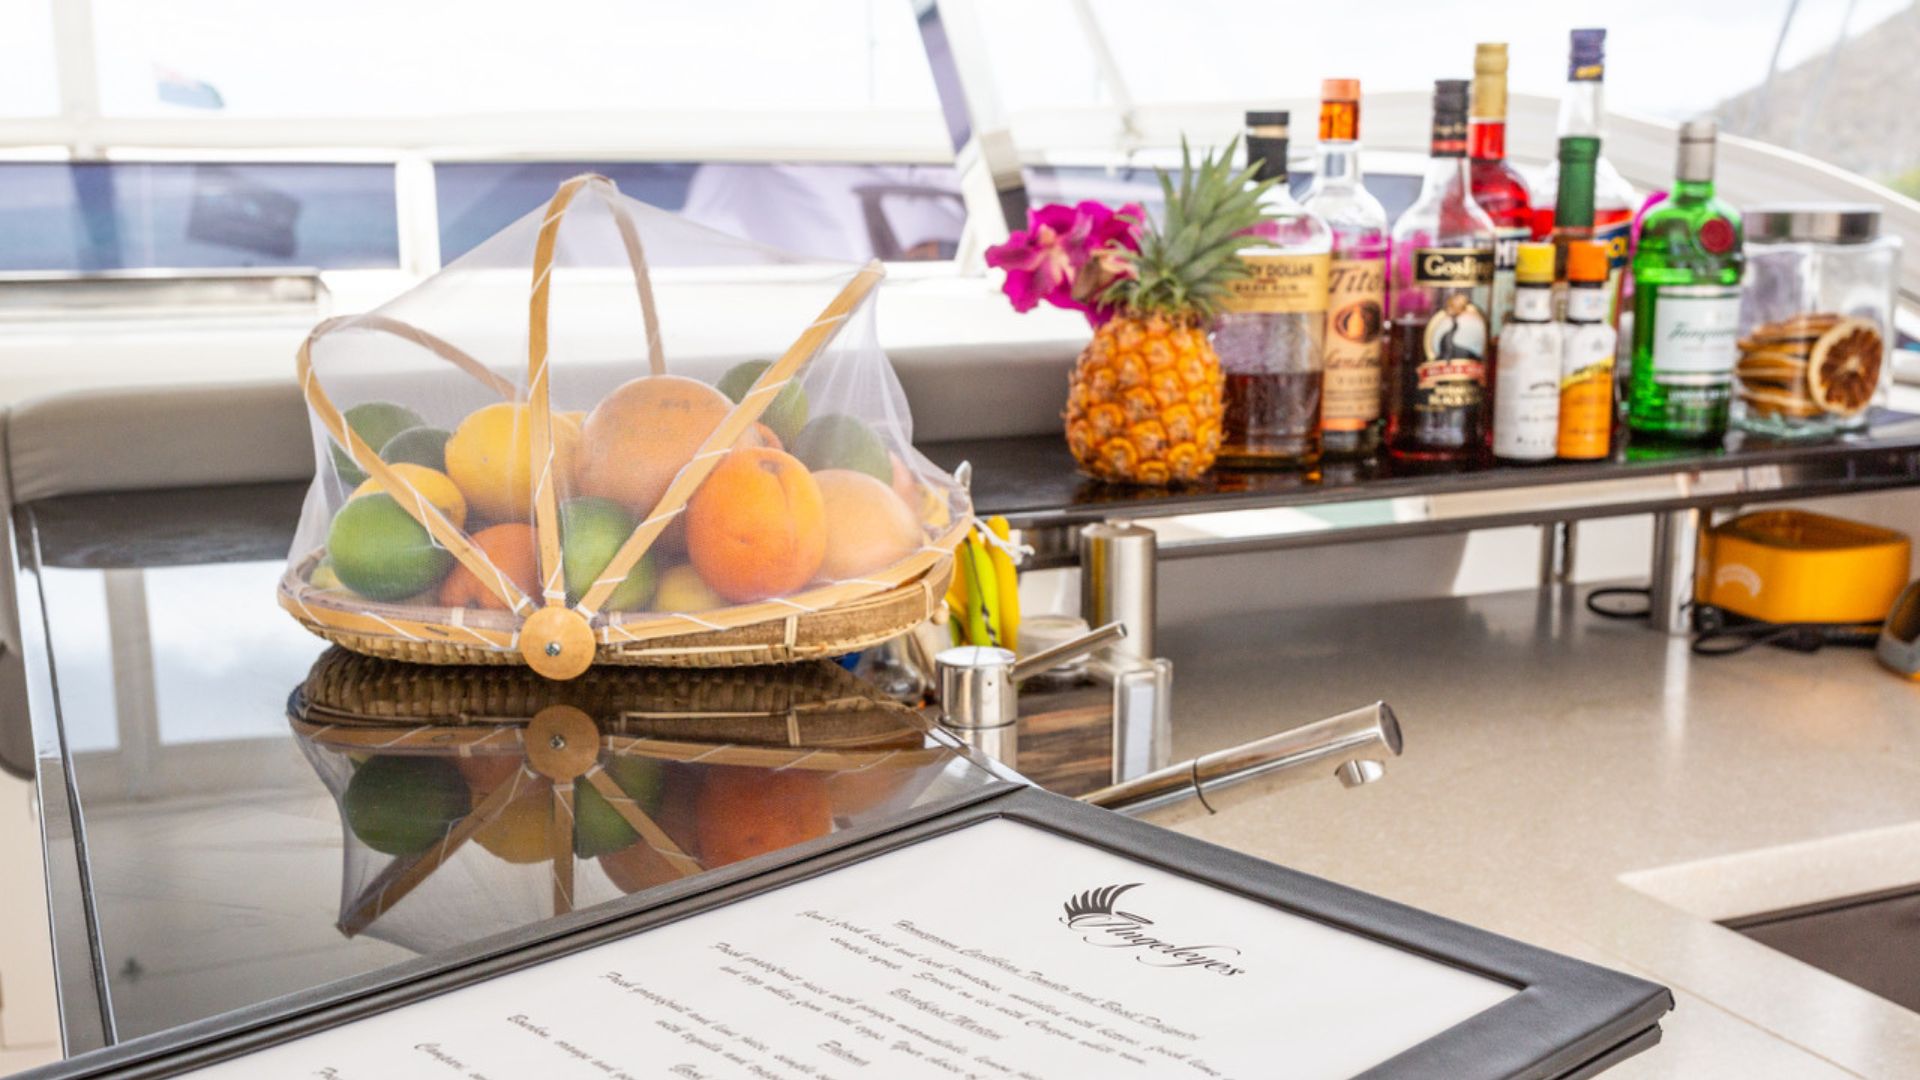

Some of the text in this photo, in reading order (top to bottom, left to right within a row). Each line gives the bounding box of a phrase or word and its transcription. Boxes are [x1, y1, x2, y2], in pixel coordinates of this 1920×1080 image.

[707, 941, 750, 958] Fresh
[1059, 911, 1245, 976] Angeleyes
[893, 947, 923, 958] and
[598, 971, 642, 988] Fresh
[912, 972, 963, 991] Served
[1071, 991, 1104, 1004] and
